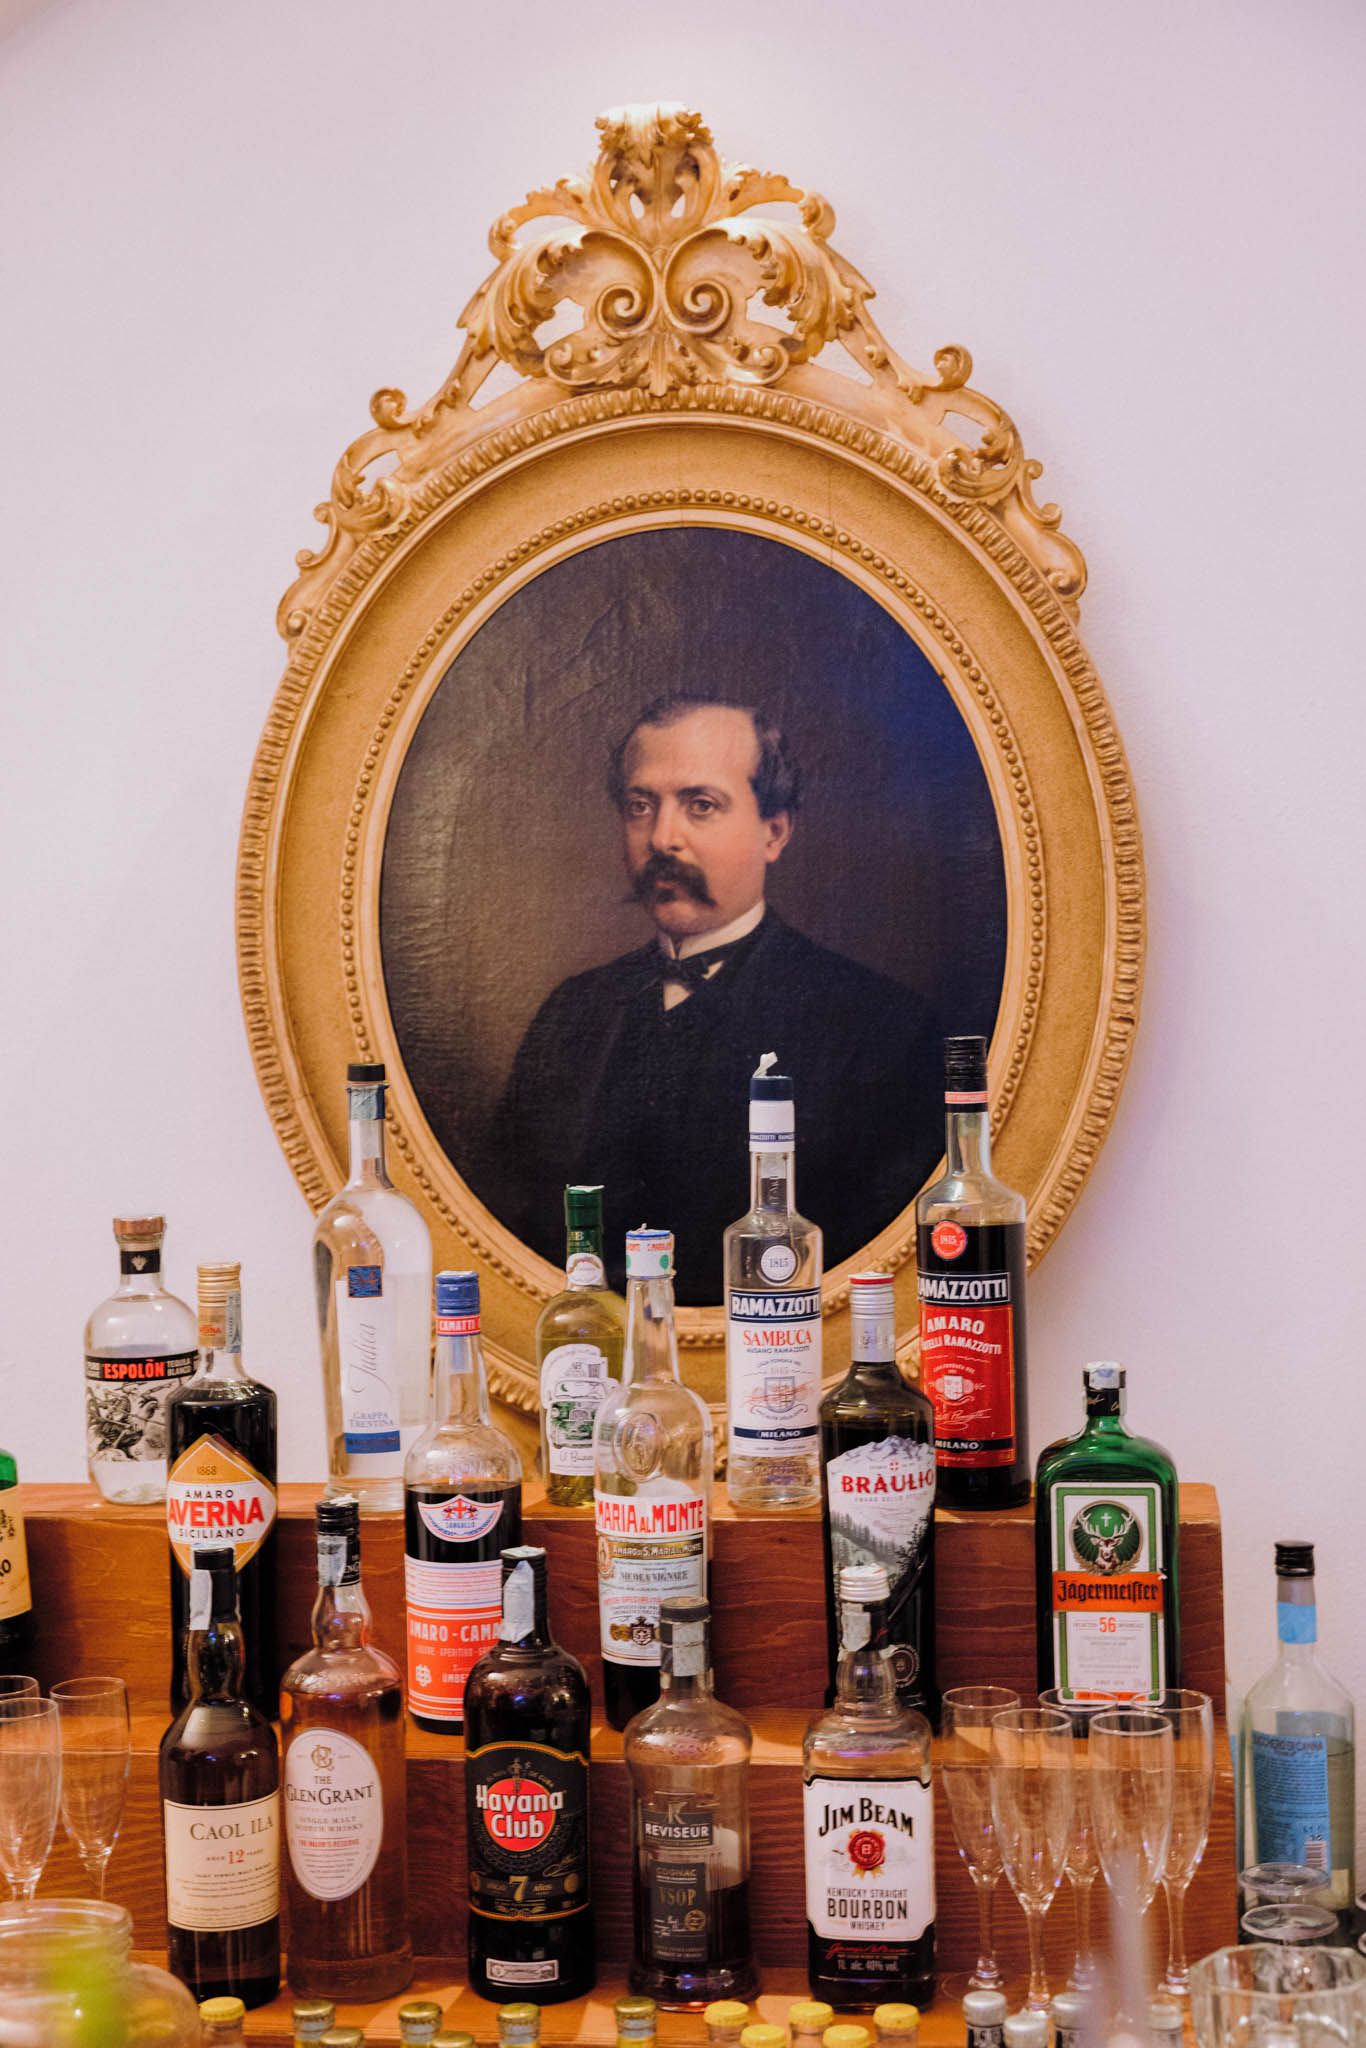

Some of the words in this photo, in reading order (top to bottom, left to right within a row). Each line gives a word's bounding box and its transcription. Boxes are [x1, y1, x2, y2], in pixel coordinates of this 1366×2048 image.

[927, 1316, 985, 1336] AMARO
[743, 1328, 813, 1348] SAMBUCA
[943, 1334, 1003, 1355] RAMAZZOTTI
[760, 1429, 801, 1438] MILANO
[934, 1439, 979, 1450] MILANO
[185, 1489, 234, 1499] AMARO
[168, 1497, 265, 1527] AVERNA
[598, 1500, 639, 1533] MARIA
[639, 1516, 652, 1534] AL
[651, 1500, 703, 1533] MONTE
[179, 1527, 245, 1539] SICILIANO
[409, 1619, 449, 1643] AMARO
[1098, 1616, 1117, 1633] 56
[314, 1775, 333, 1785] THE
[475, 1784, 564, 1813] Havana
[490, 1813, 545, 1839] Club
[818, 1804, 855, 1838] JIM
[859, 1797, 915, 1838] BEAM
[189, 1822, 245, 1841] CAOL
[250, 1815, 274, 1835] ILA
[644, 1823, 710, 1839] REVISEUR
[228, 1849, 245, 1865] 12
[508, 1875, 529, 1903] 7
[657, 1885, 697, 1907] VSOP
[826, 1887, 867, 1898] KENTUCKY
[870, 1888, 909, 1899] STRAIGHT
[827, 1898, 909, 1920] BOURBON
[850, 1920, 886, 1931] WHISKEY
